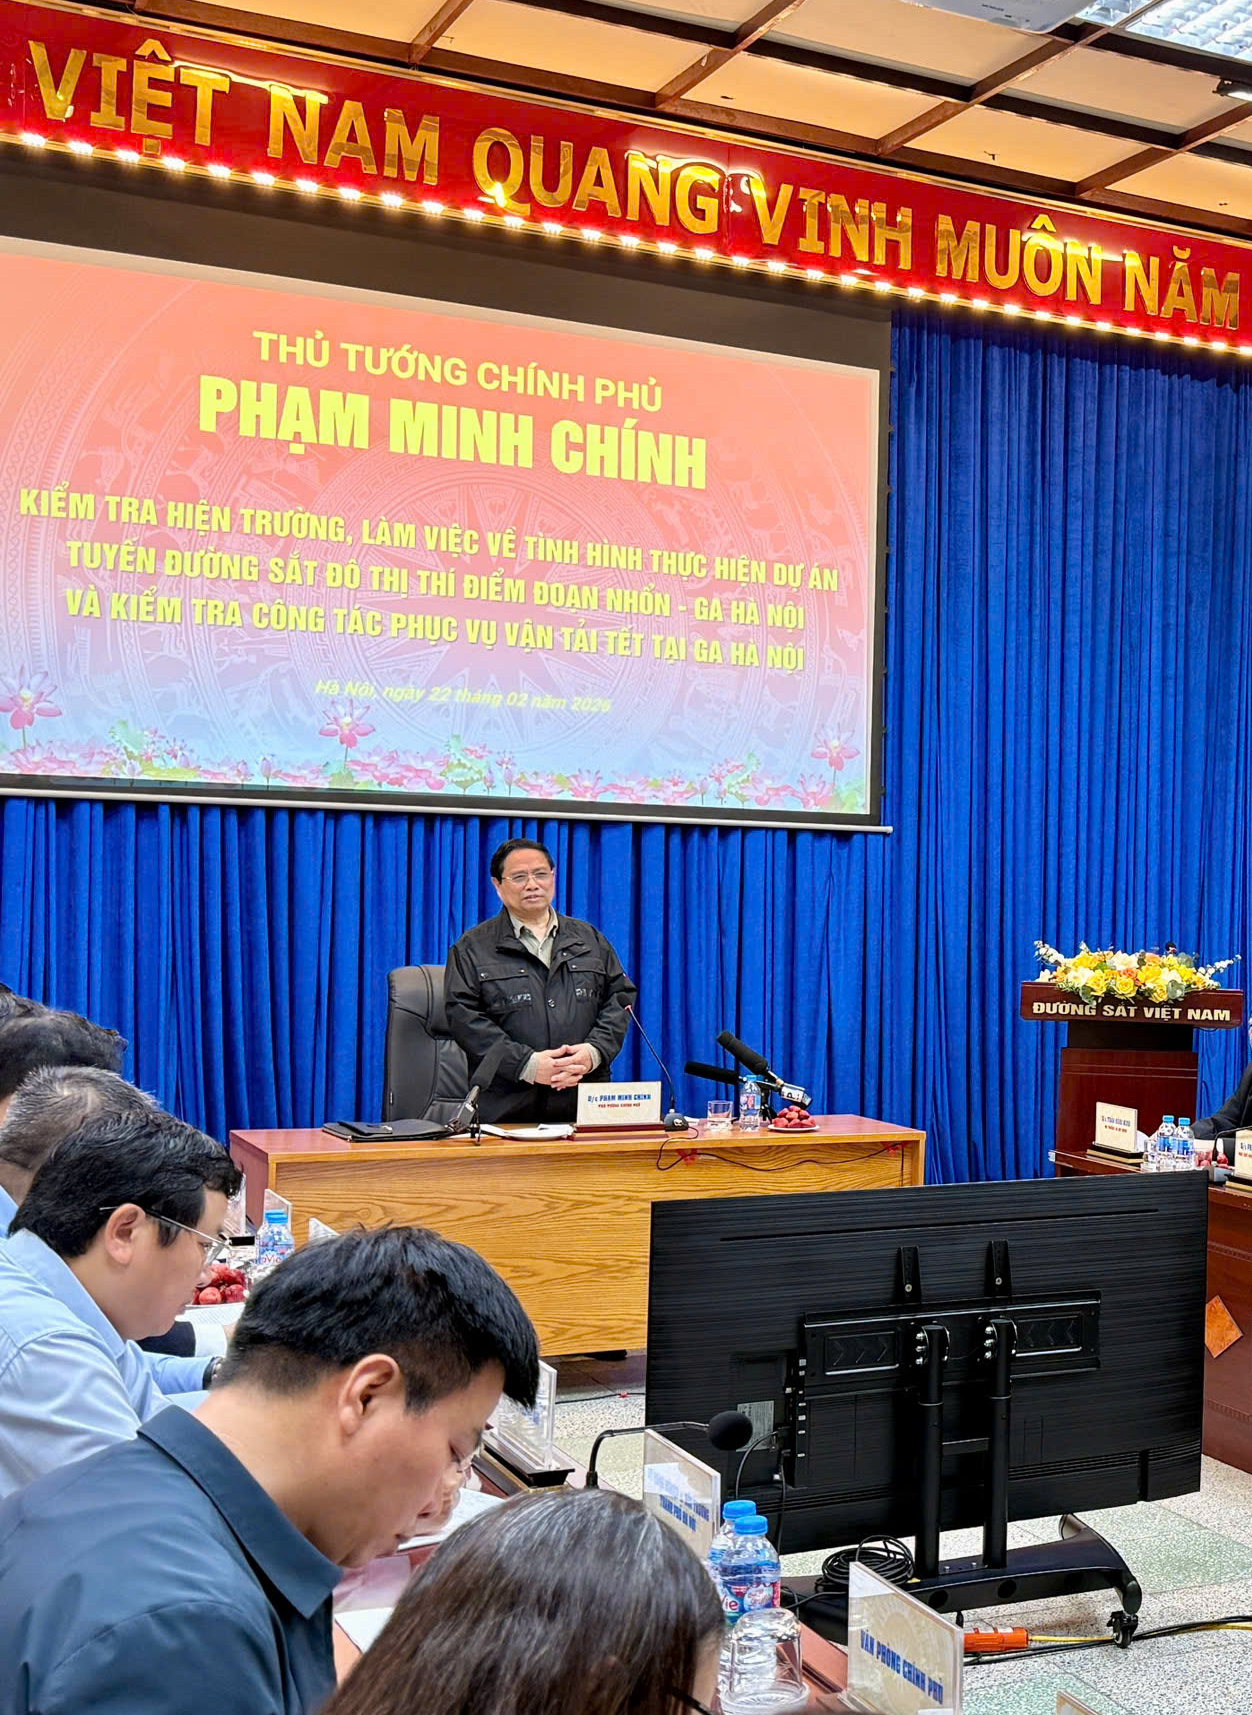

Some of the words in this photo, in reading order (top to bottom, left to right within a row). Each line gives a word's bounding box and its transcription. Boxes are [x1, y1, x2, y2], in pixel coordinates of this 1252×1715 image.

[27, 38, 230, 158] VIỆT
[267, 85, 440, 186] NAM
[471, 127, 722, 235] QUANG
[747, 170, 912, 270] VINH
[936, 214, 1102, 305] MUÔN
[1123, 246, 1240, 330] NĂM
[253, 330, 330, 368] THỦ
[340, 341, 467, 386] TƯỚNG
[477, 362, 584, 402] CHÍNH
[595, 377, 662, 413] PHỦ
[200, 374, 370, 455] PHẠM
[389, 397, 533, 469] MINH
[551, 418, 706, 490] CHÍNH
[20, 481, 95, 521] KIỂM
[105, 495, 158, 526] TRA
[167, 500, 231, 536] HIỆN
[240, 507, 353, 546] TRƯỜNG,
[362, 517, 416, 549] LÀM
[424, 525, 479, 558] VIỆC
[488, 527, 516, 559] VỀ
[525, 533, 579, 565] TÌNH
[587, 542, 643, 572] HÌNH
[651, 549, 707, 579] THỰC
[715, 555, 767, 589] HIỆN
[774, 562, 806, 589] DỰ
[809, 564, 838, 592] ÁN
[66, 585, 100, 618] VÀ
[111, 585, 182, 624] KIỂM
[192, 598, 243, 627] TRA
[252, 599, 325, 632] CÔNG
[334, 604, 382, 637] TÁC
[391, 612, 457, 645] PHỤC
[466, 620, 497, 650] VỤ
[504, 618, 553, 654] VẬN
[561, 618, 597, 653] TẢI
[606, 625, 644, 657] TẾT
[652, 634, 686, 665] TẠI
[694, 639, 723, 664] GA
[731, 639, 760, 667] HÀ
[767, 644, 804, 672] NỘI
[67, 537, 156, 574] TUYẾN
[164, 547, 259, 583] ĐƯỜNG
[269, 553, 317, 586] SẮT
[326, 559, 361, 590] ĐÔ
[371, 566, 409, 598] THỊ
[417, 570, 456, 598] THÍ
[463, 567, 526, 603] ĐIỂM
[534, 583, 599, 614] ĐOẠN
[606, 583, 671, 617] NHỔN
[694, 596, 723, 622] GA
[731, 597, 760, 625] HÀ
[767, 601, 805, 633] NỘI
[428, 686, 452, 702] 22
[507, 692, 528, 707] 02
[1032, 1000, 1096, 1016] ĐƯỜNG
[1143, 1005, 1182, 1021] VIỆT
[1187, 1008, 1231, 1021] NAM
[876, 1640, 901, 1675] PHÒNG
[903, 1659, 926, 1693] CHÍNH
[927, 1676, 944, 1706] PHỦ
